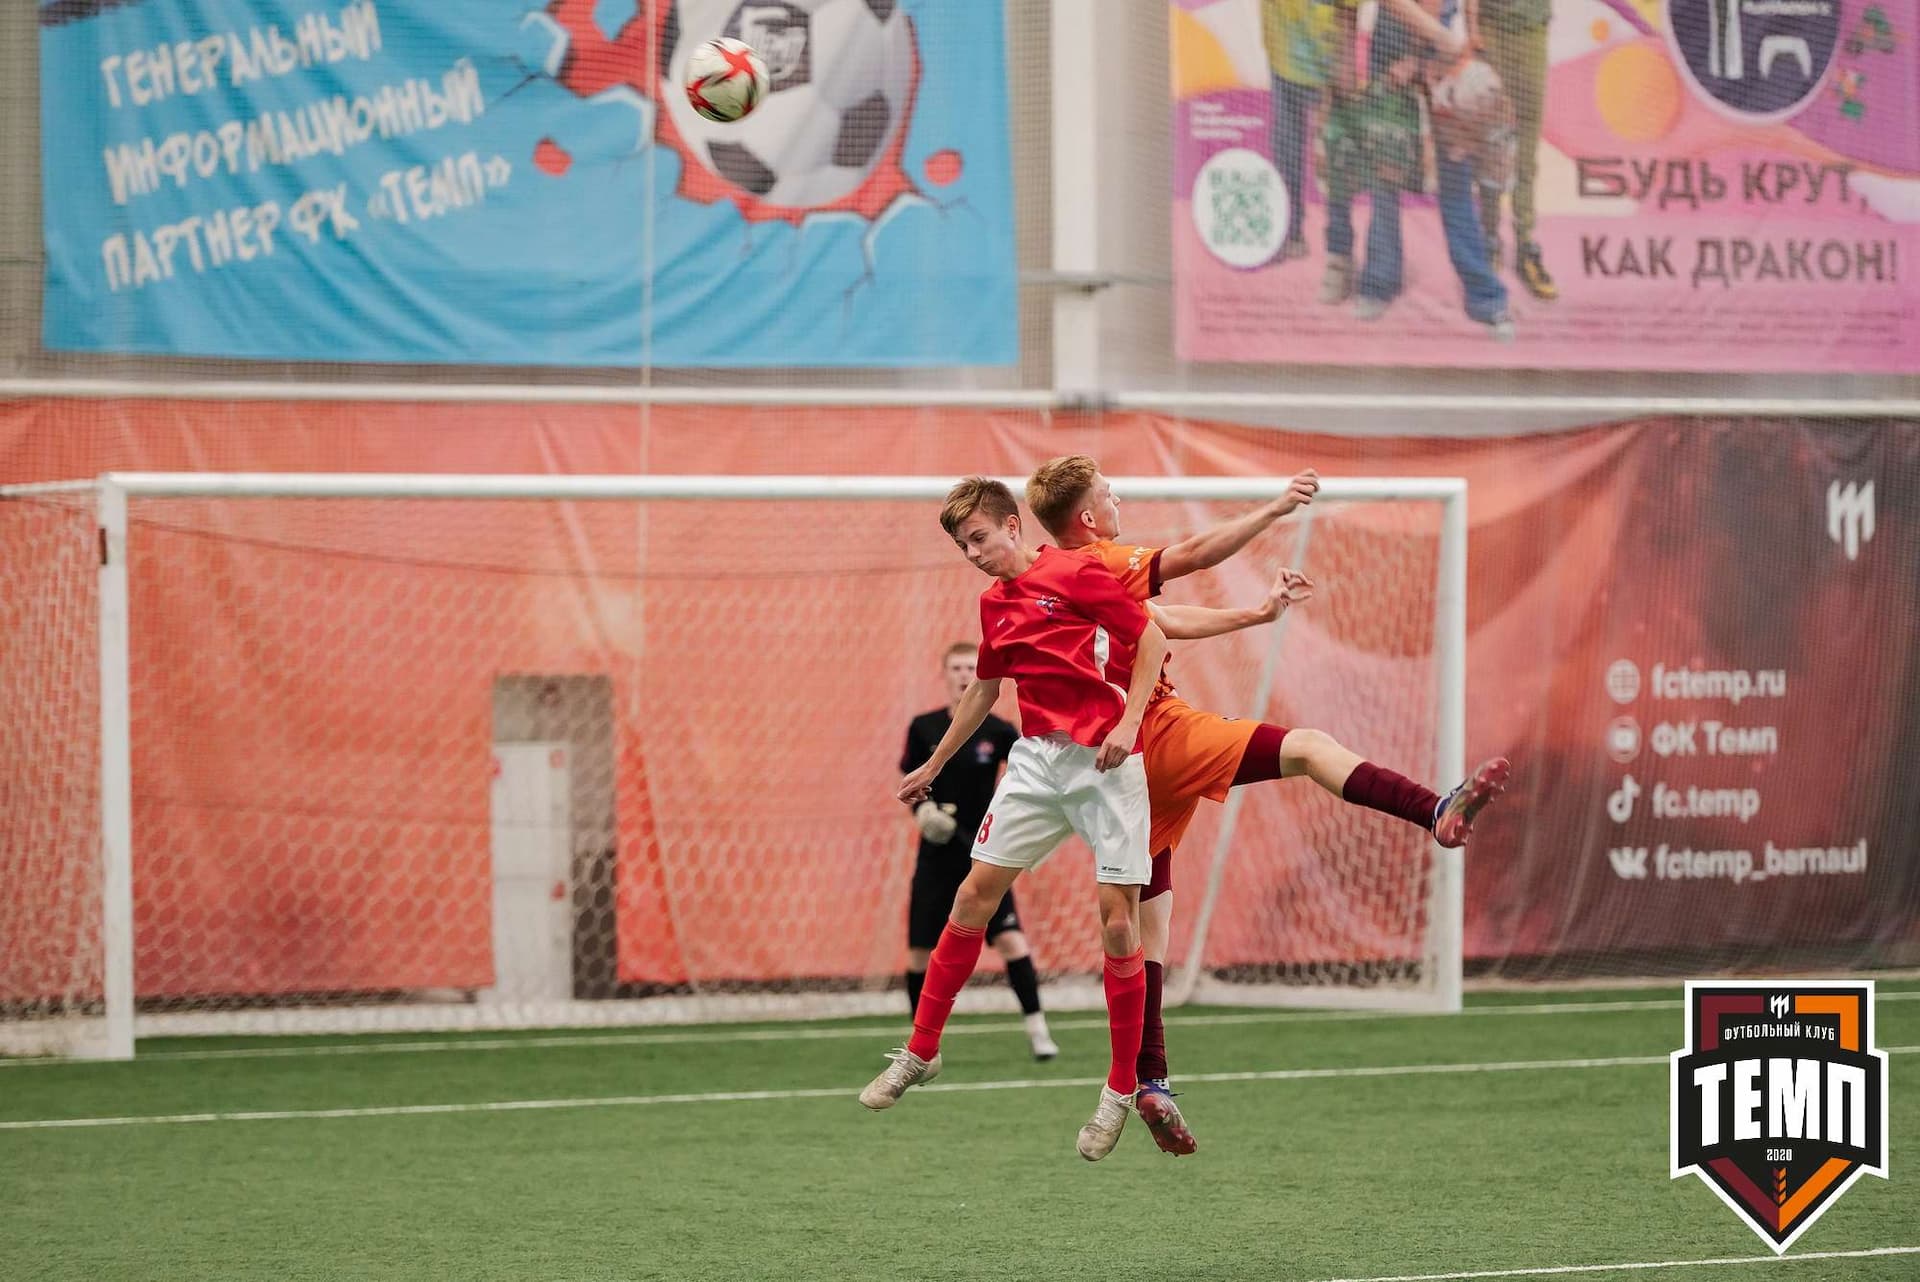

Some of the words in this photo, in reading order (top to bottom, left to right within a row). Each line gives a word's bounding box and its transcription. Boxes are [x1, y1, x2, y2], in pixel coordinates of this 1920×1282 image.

[101, 0, 382, 108] ГЕНЕРАЛЬНЫЙ
[104, 58, 484, 205] ИНФОРМАЦИОННЫЙ
[1577, 158, 1727, 210] БУДЬ
[1742, 161, 1867, 213] КРУТ,
[102, 203, 281, 291] ПАРТНЕР
[288, 184, 360, 244] ФК
[1580, 236, 1676, 278] КАК
[1692, 240, 1897, 288] ДРАКОН!
[1651, 662, 1787, 705] fctemp.ru
[1651, 721, 1697, 757] ФК
[1701, 720, 1778, 755] Темп
[1652, 781, 1761, 823] fc.temp
[1654, 838, 1868, 884] fctemp_barnaul
